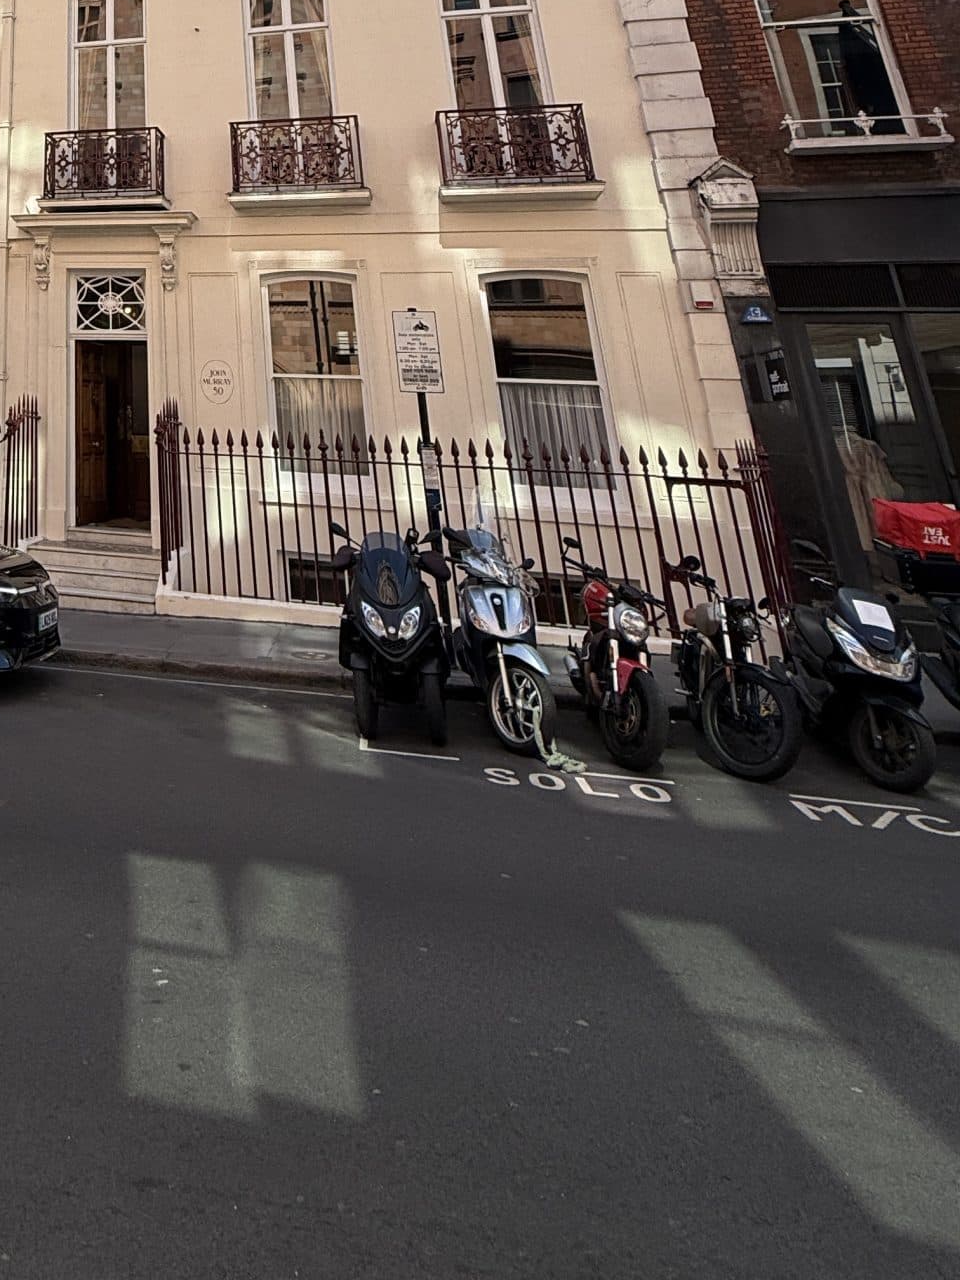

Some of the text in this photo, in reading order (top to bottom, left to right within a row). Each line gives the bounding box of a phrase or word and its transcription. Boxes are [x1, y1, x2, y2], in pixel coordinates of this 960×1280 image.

[209, 369, 227, 377] JOHN
[212, 386, 224, 396] 50
[923, 526, 943, 536] EAT
[923, 535, 951, 546] JUST
[482, 767, 672, 803] SOLO
